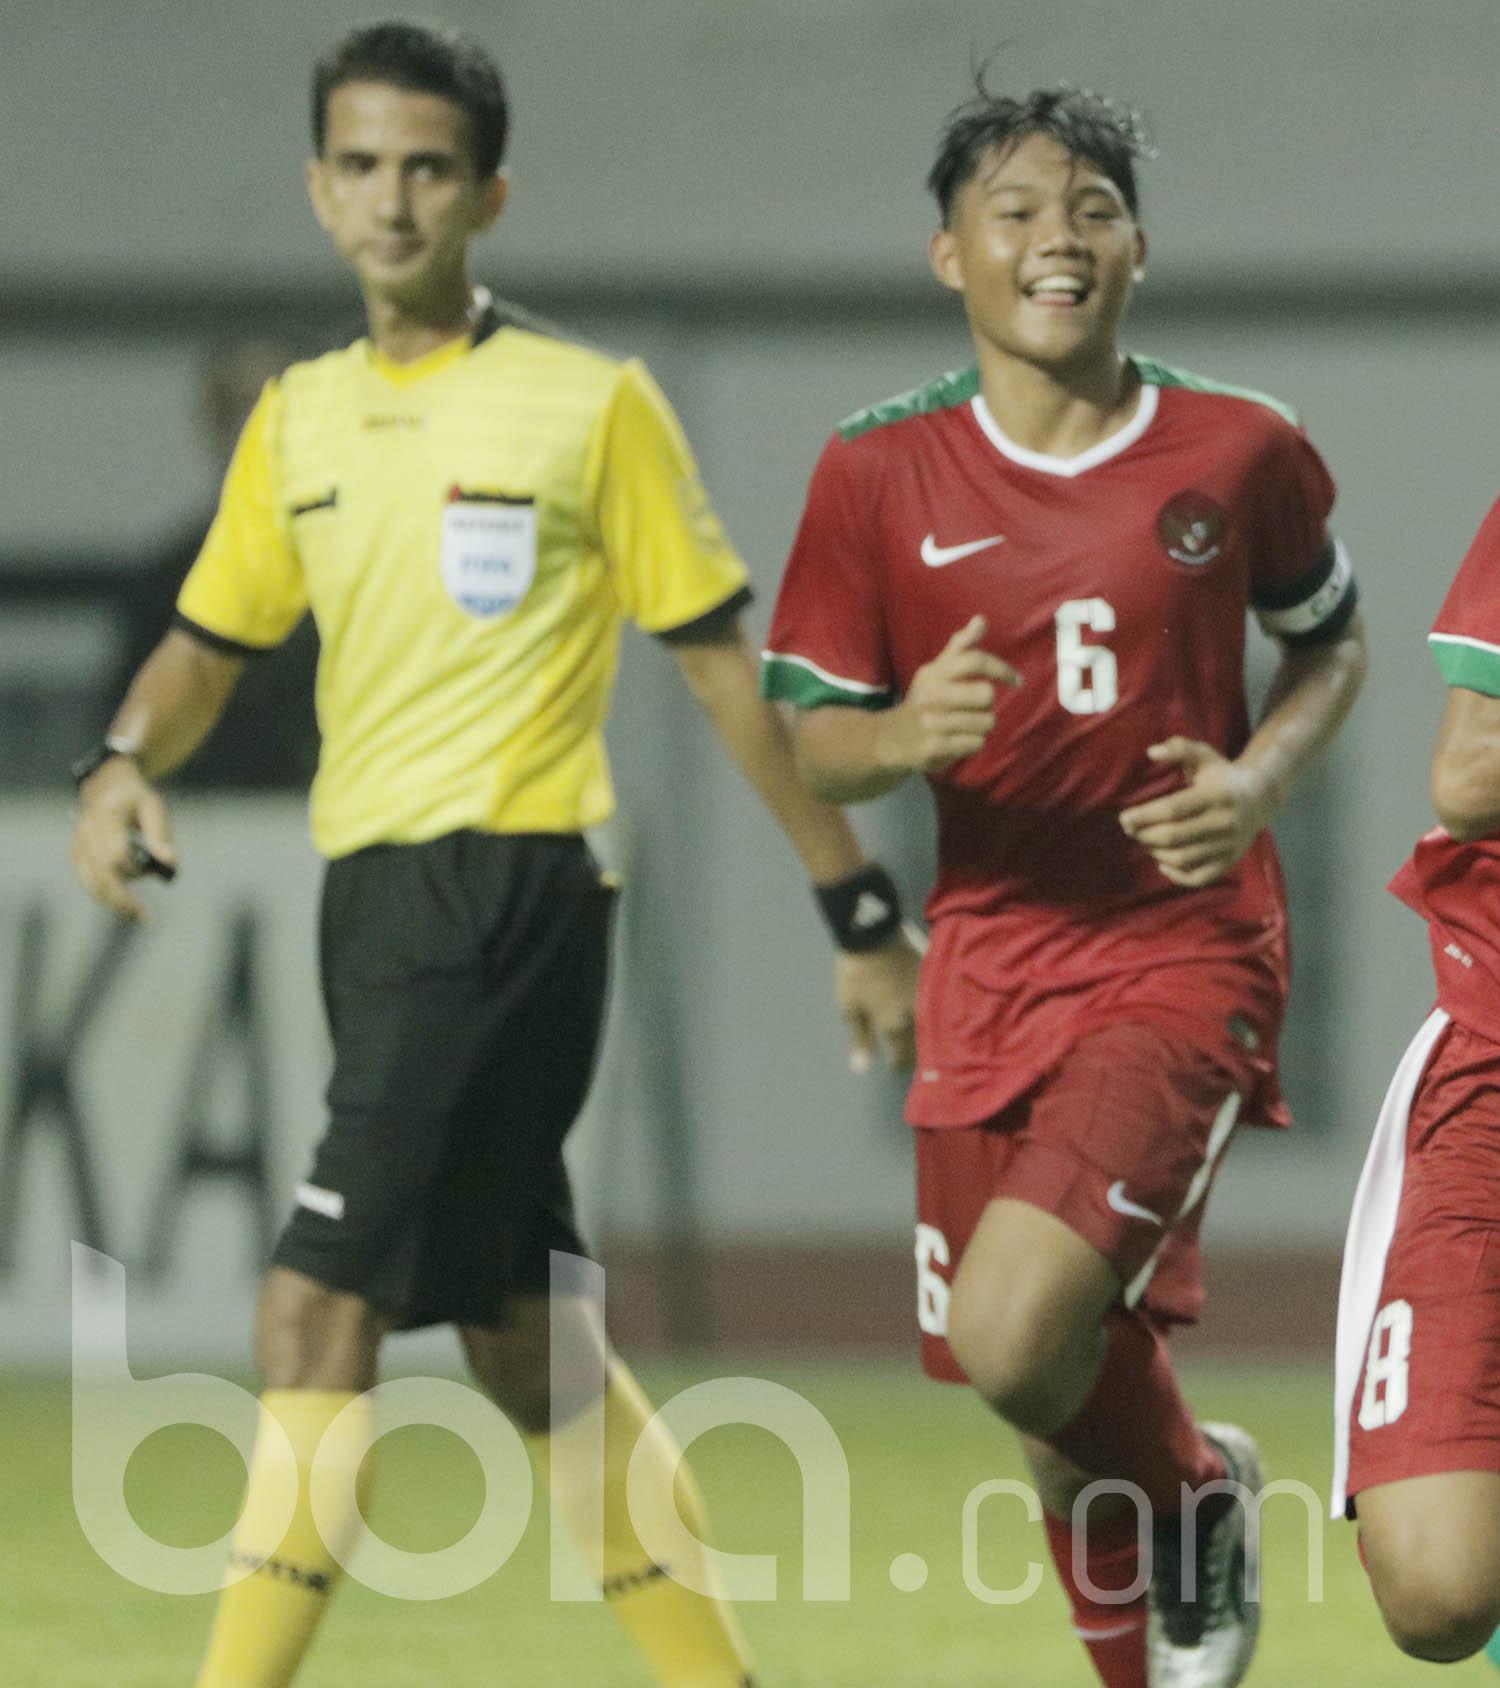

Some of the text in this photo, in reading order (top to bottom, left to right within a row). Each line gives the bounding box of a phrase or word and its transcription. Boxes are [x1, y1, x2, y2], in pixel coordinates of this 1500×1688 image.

[1054, 598, 1118, 715] 6
[914, 1222, 951, 1337] 6
[1358, 1299, 1414, 1431] 8
